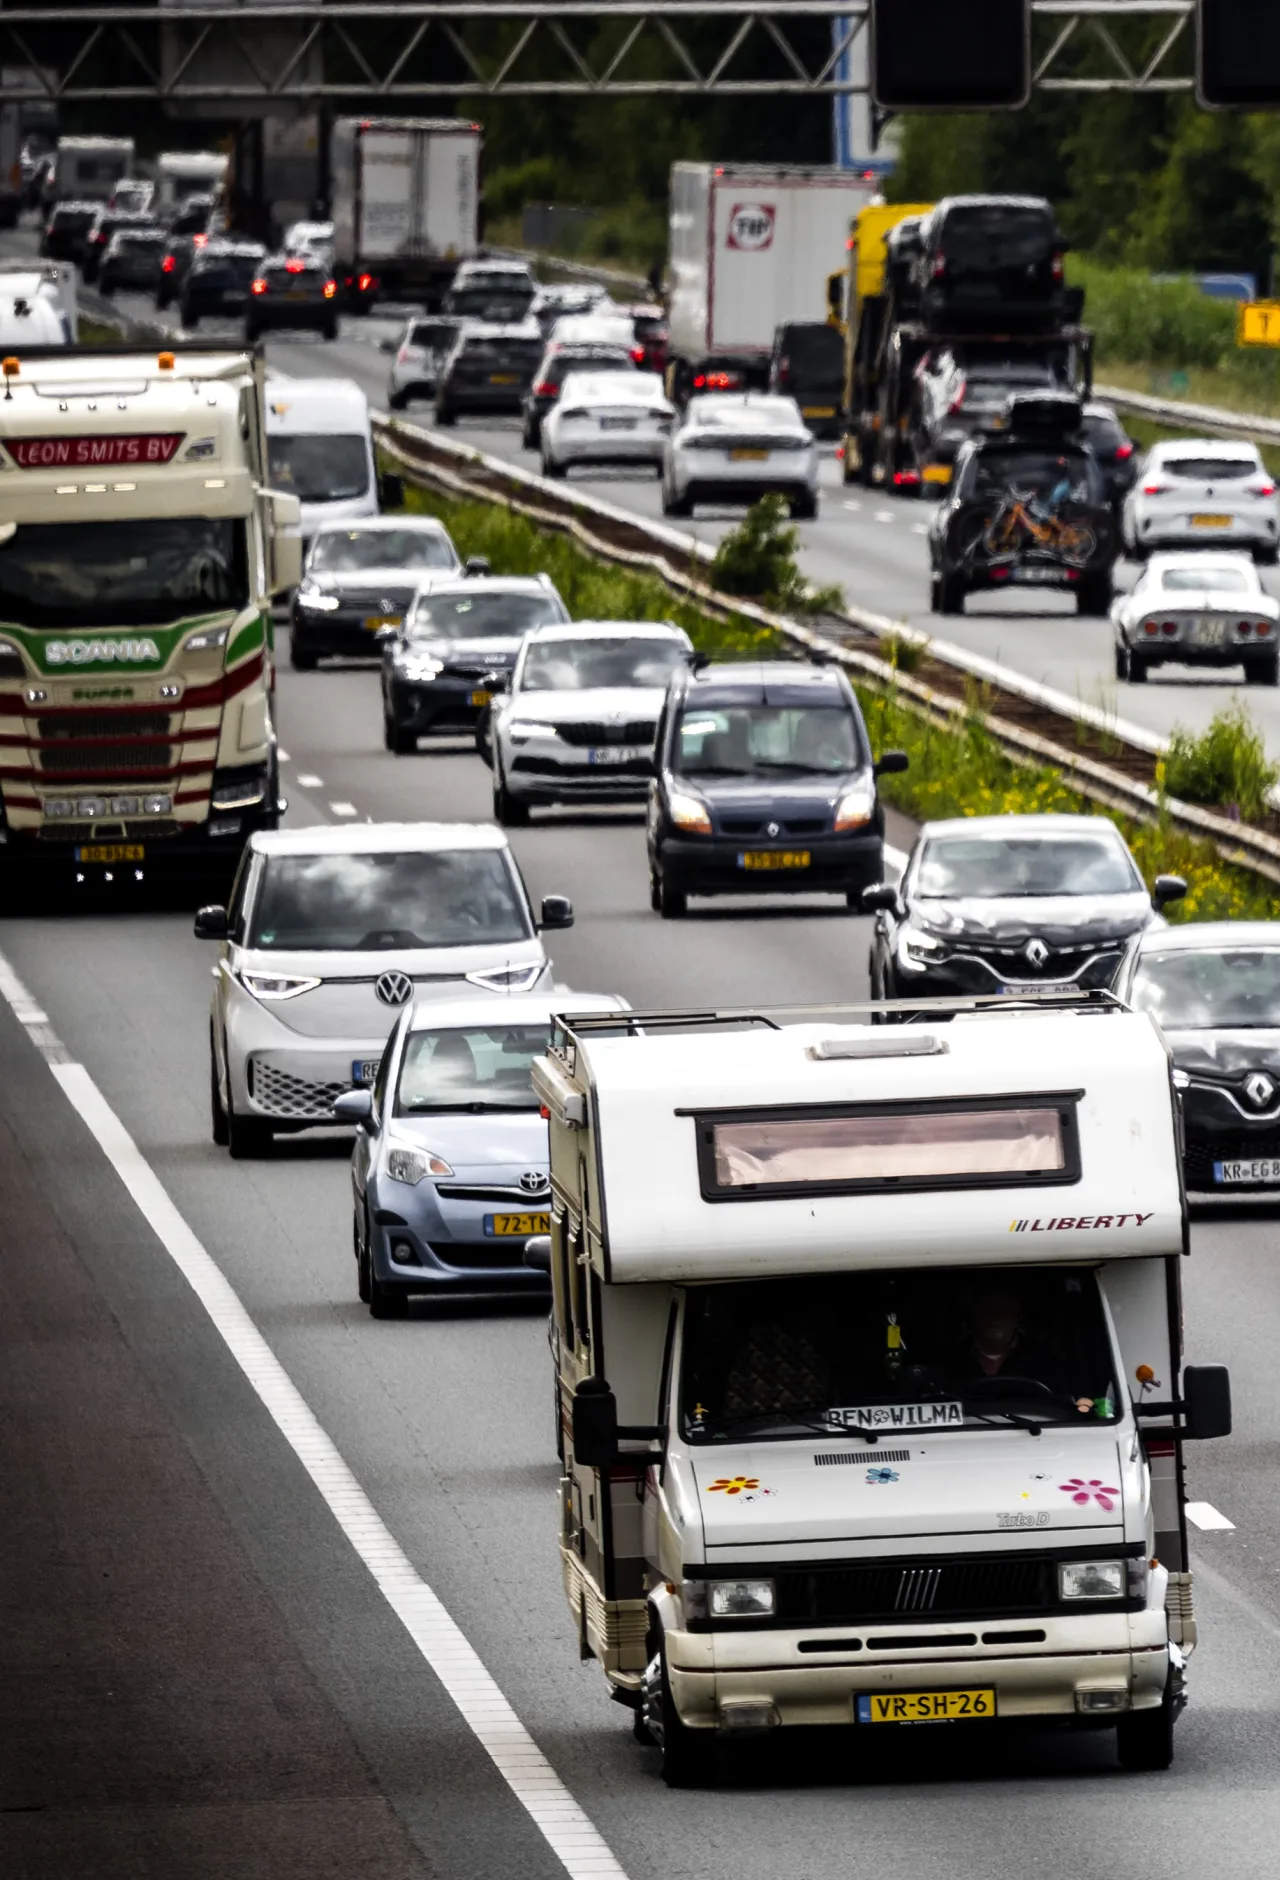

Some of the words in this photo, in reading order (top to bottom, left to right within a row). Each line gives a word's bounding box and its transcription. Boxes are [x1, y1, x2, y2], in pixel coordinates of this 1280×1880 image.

[18, 443, 71, 463] LEON
[77, 440, 139, 460] SMITS
[147, 437, 175, 459] BV
[45, 638, 160, 664] SCANIA
[1223, 1164, 1241, 1180] KR
[1251, 1162, 1269, 1178] EG
[1030, 1213, 1155, 1232] LIBERTY
[890, 1403, 962, 1426] WILMA
[996, 1512, 1035, 1528] Turbo
[1035, 1511, 1051, 1526] D
[876, 1694, 987, 1718] VR-SH-26
